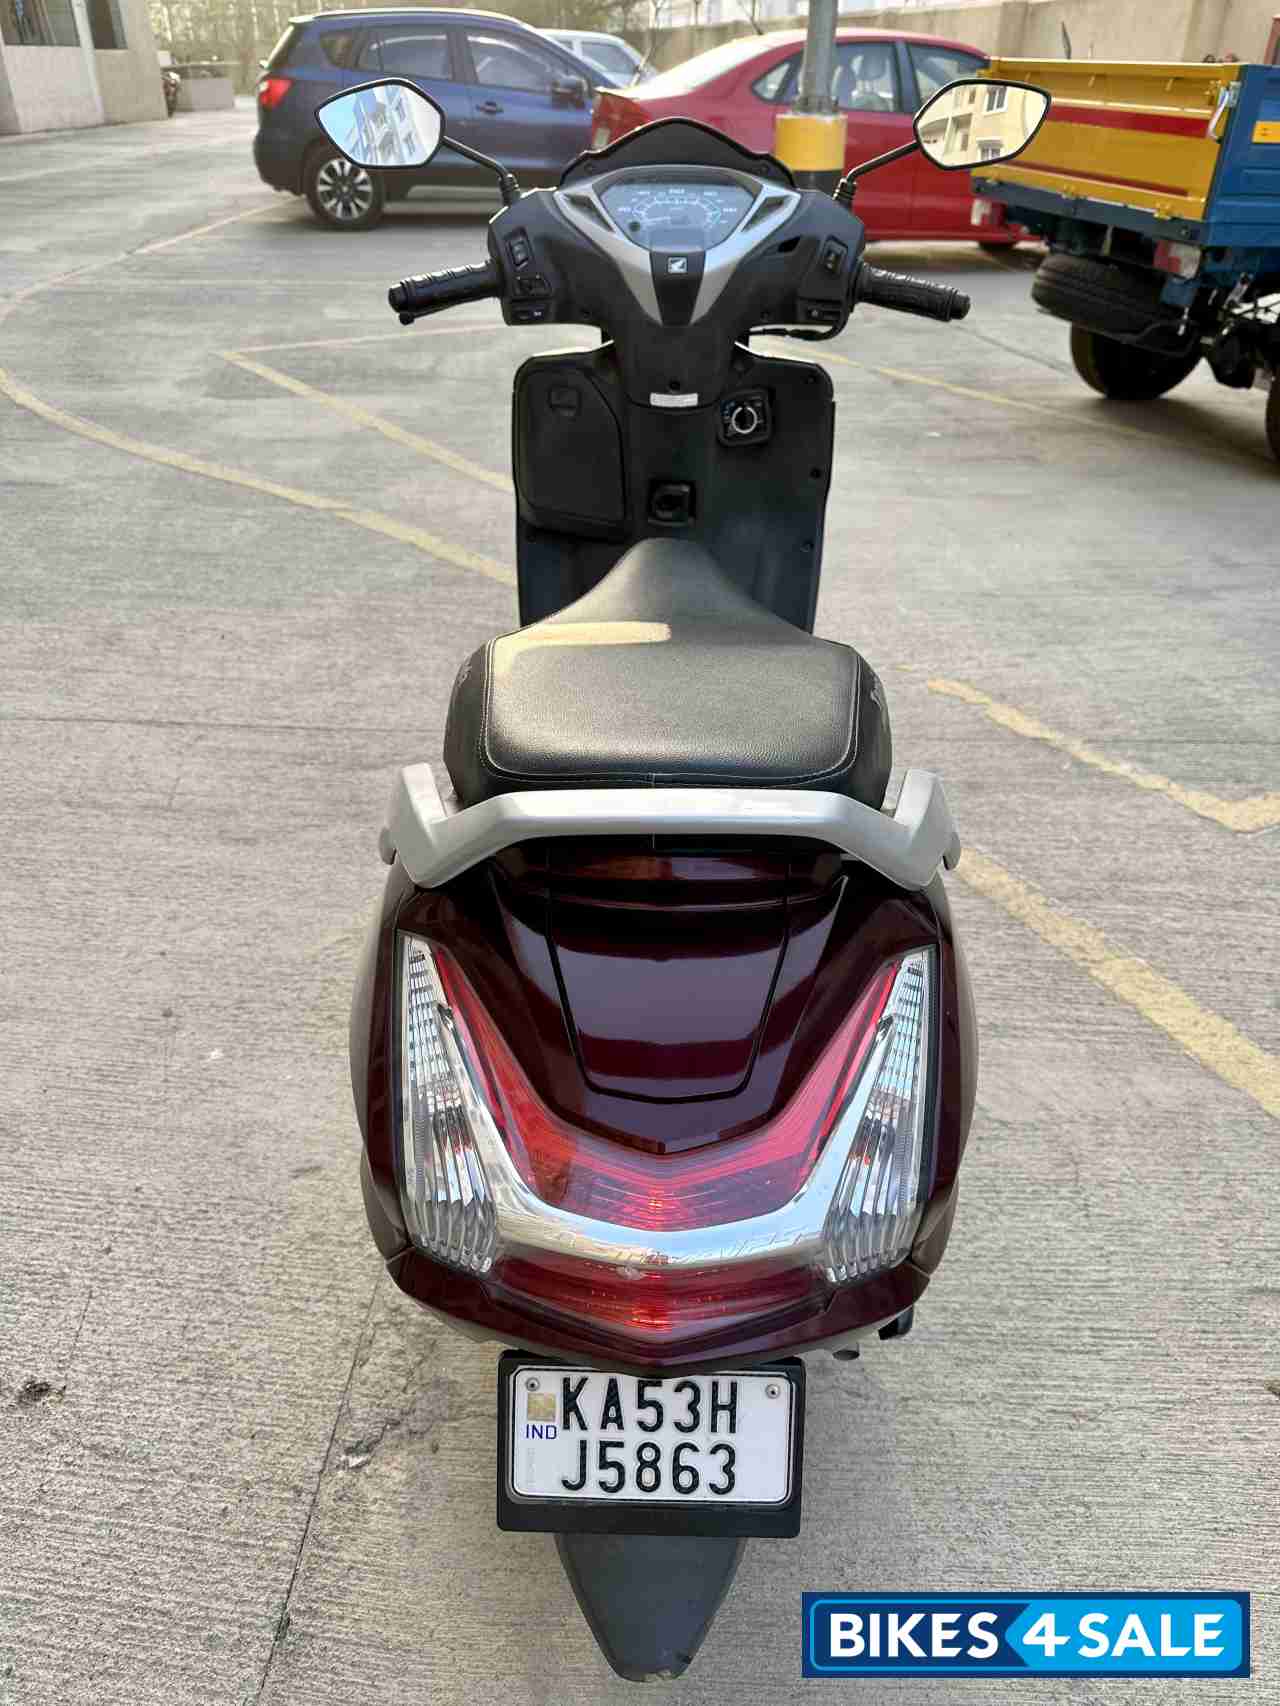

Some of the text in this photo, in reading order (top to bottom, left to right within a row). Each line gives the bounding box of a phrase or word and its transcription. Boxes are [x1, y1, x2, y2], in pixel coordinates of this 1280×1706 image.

[526, 1424, 557, 1439] IND
[562, 1377, 738, 1433] KA53H
[561, 1440, 736, 1494] J5863
